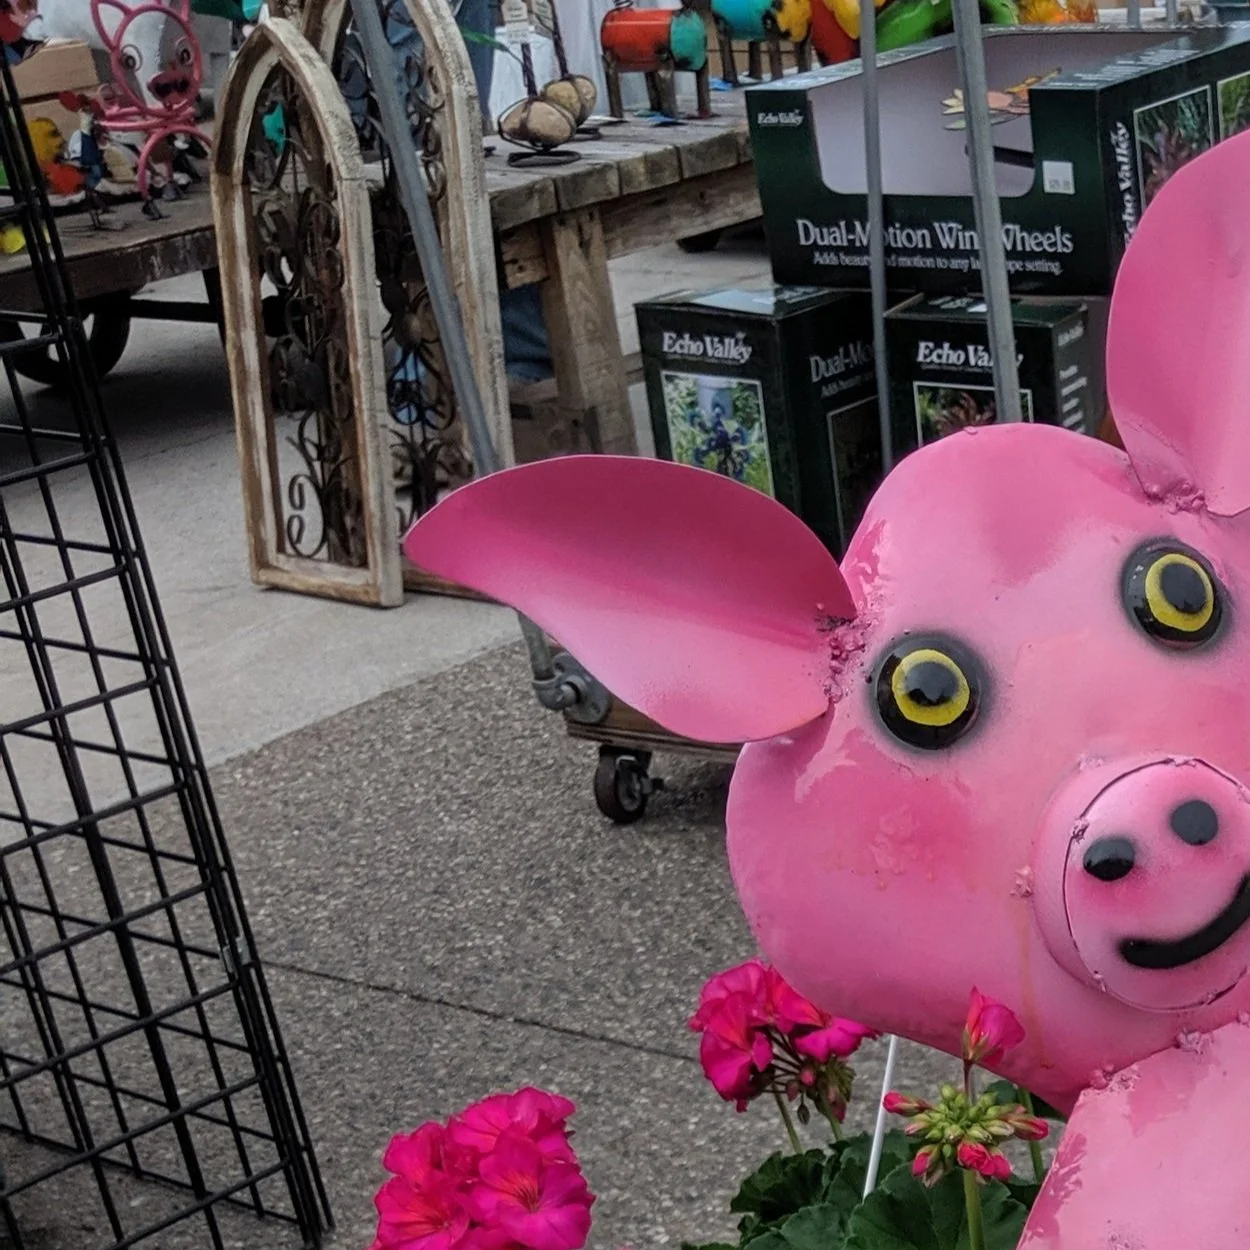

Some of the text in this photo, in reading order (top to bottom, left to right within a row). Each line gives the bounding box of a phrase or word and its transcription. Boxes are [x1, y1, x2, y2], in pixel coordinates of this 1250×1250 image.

[1110, 121, 1132, 192] Valley
[662, 331, 703, 354] Echo
[703, 334, 752, 364] Valley
[917, 340, 966, 364] Echo
